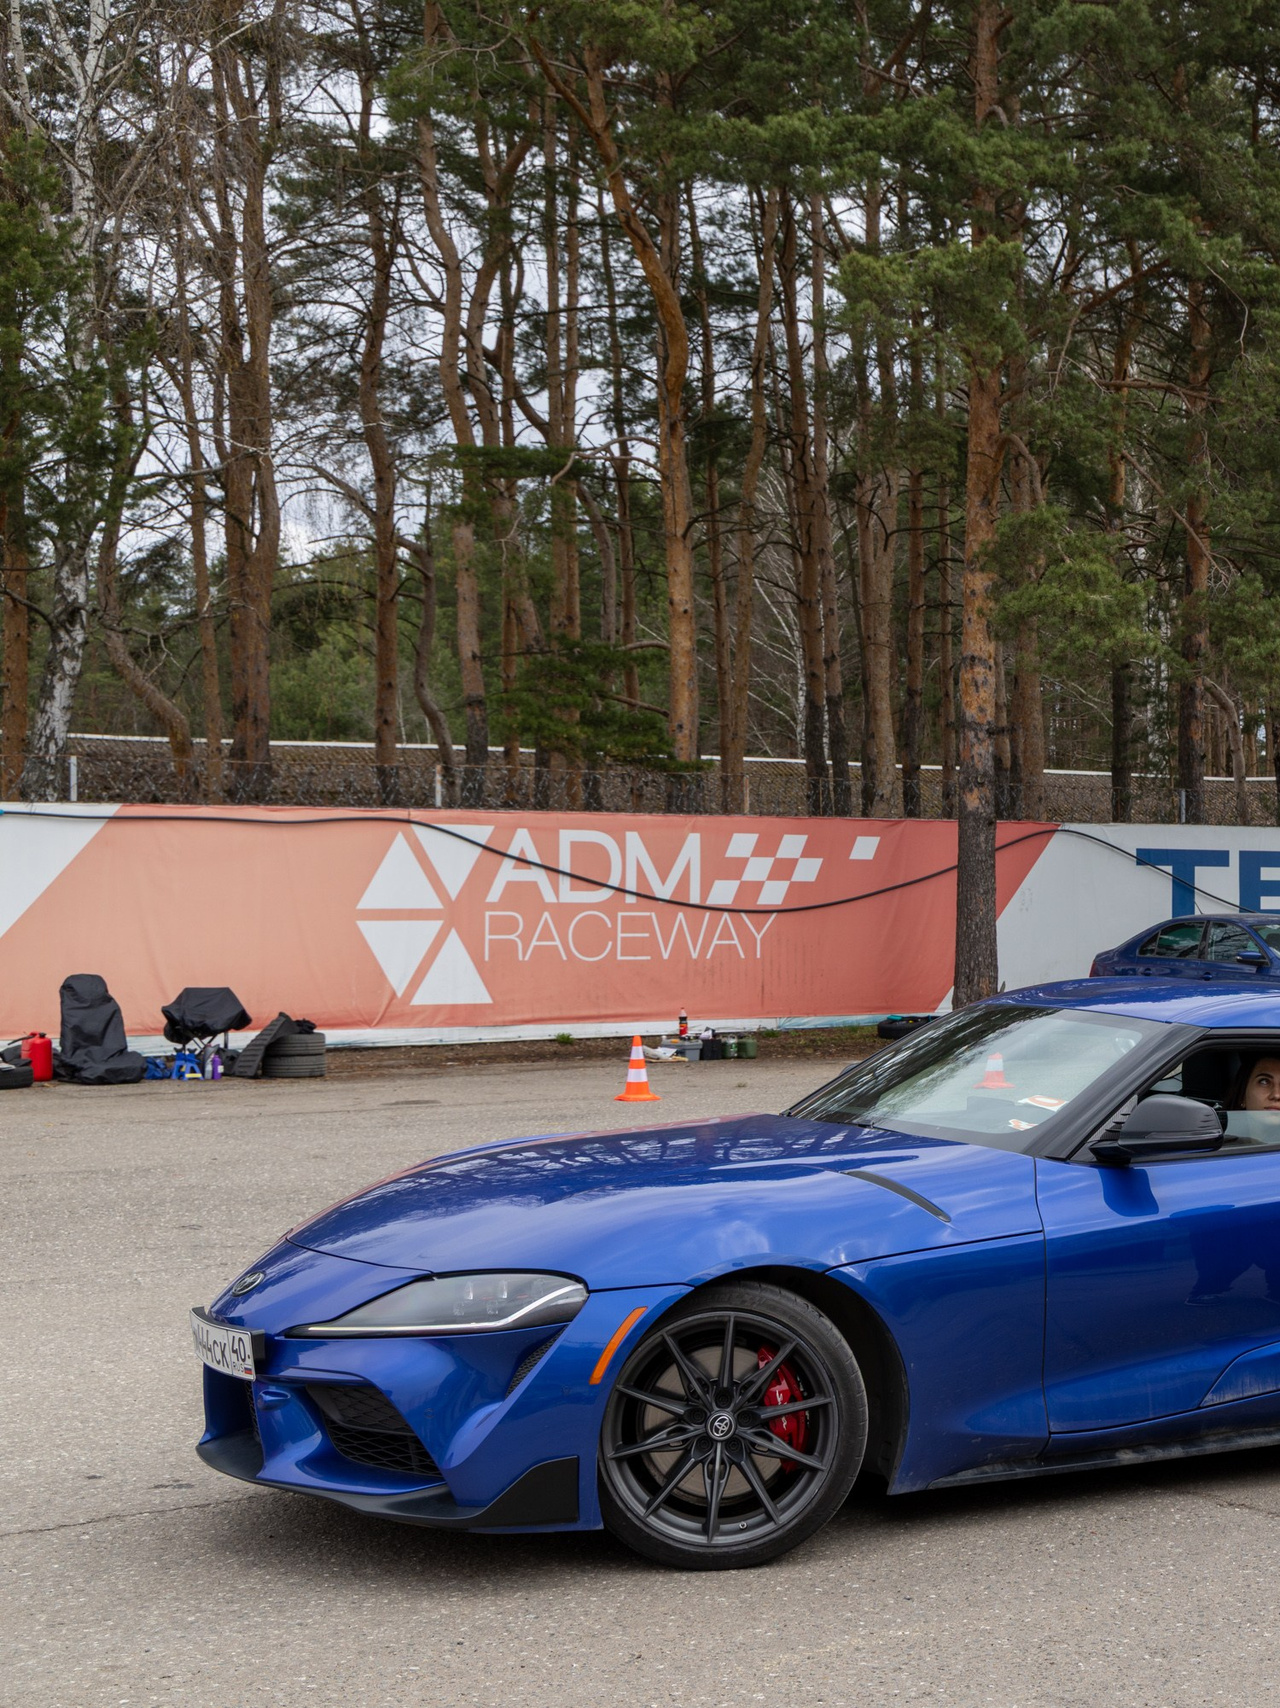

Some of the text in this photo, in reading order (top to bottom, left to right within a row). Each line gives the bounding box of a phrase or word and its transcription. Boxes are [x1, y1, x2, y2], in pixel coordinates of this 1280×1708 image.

[485, 828, 701, 904] ADM
[484, 911, 778, 962] RACEWAY
[232, 1335, 247, 1363] 40
